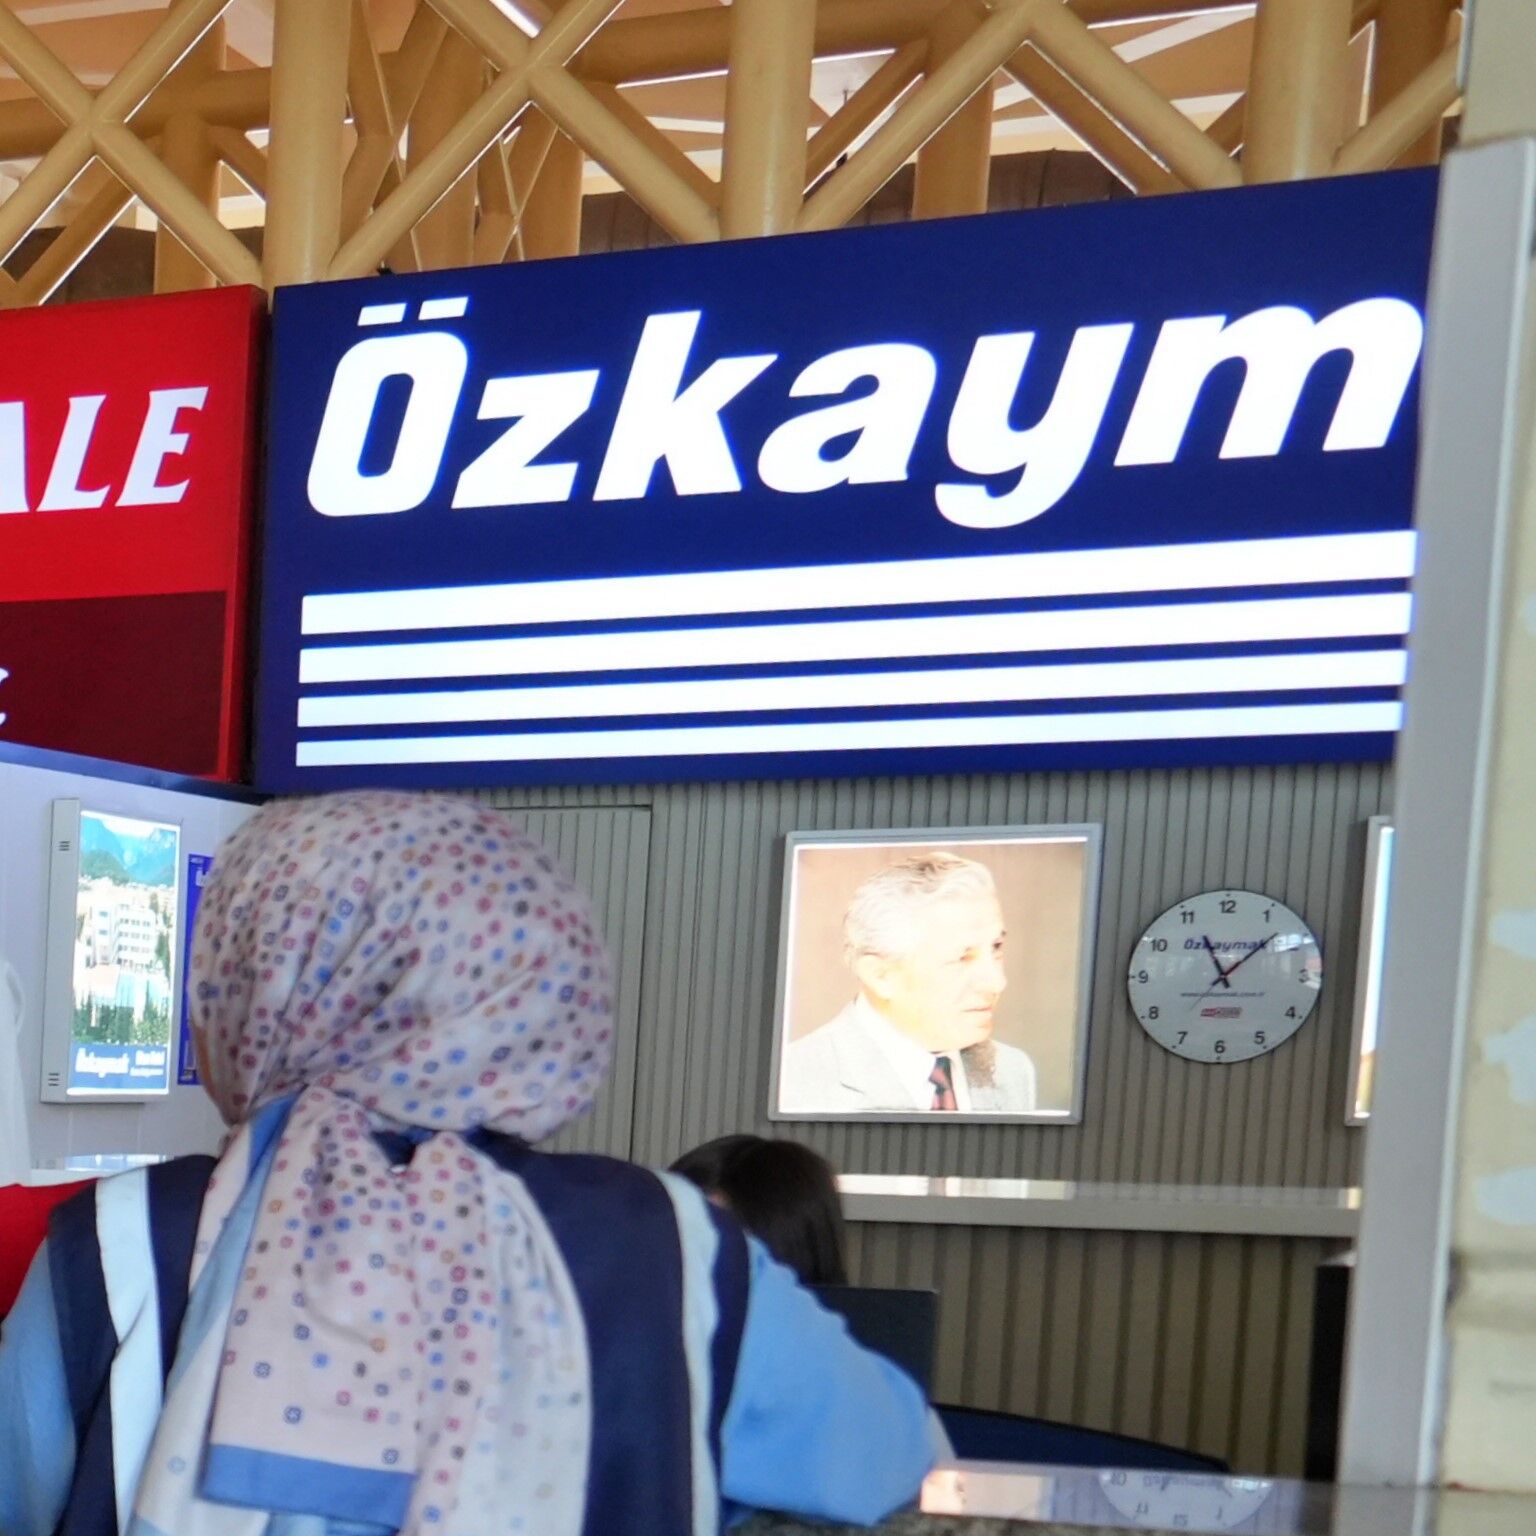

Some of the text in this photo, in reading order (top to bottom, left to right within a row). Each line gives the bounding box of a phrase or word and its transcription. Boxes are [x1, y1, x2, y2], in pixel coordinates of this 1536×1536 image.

[1219, 900, 1236, 914] 12
[1180, 911, 1194, 924] 11
[1263, 910, 1270, 922] 1
[1150, 938, 1168, 952] 10
[1138, 970, 1149, 984] 9
[1148, 1006, 1159, 1020] 8
[1284, 1006, 1296, 1019] 4
[1177, 1031, 1188, 1045] 7
[1254, 1031, 1265, 1045] 5
[1214, 1040, 1225, 1054] 6
